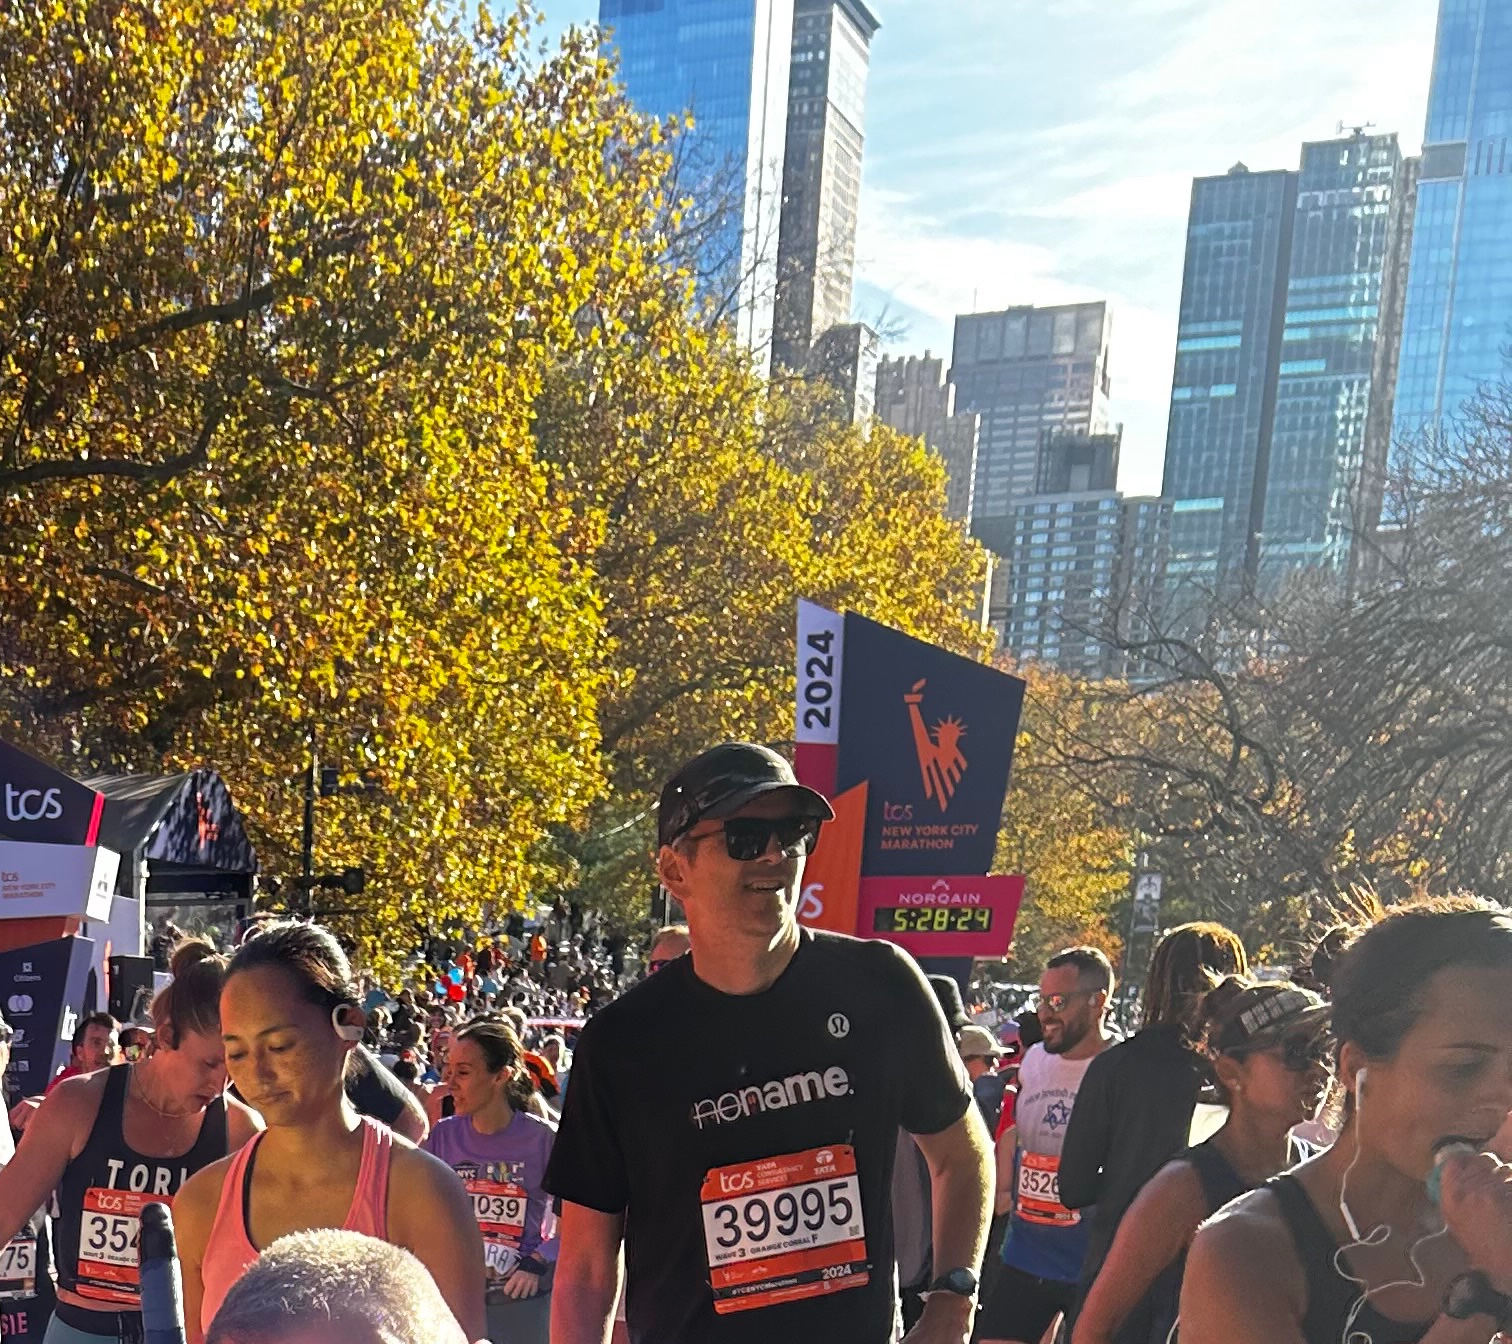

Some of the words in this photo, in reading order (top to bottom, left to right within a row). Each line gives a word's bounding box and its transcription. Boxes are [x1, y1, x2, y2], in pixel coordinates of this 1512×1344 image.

[803, 630, 835, 729] 2024
[5, 783, 63, 821] tcs
[883, 801, 913, 821] tcs
[882, 827, 912, 837] NEW
[916, 825, 947, 836] YORK
[950, 824, 979, 835] CITY
[881, 838, 954, 850] MARATHON
[899, 893, 981, 905] NORQAIN
[813, 1165, 836, 1175] TATA
[719, 1171, 754, 1193] tcs
[97, 1192, 122, 1210] tcs
[714, 1182, 853, 1247] 39995
[99, 1251, 105, 1259] 3
[738, 1248, 746, 1258] 3
[811, 1234, 818, 1243] F
[822, 1264, 852, 1280] 2024
